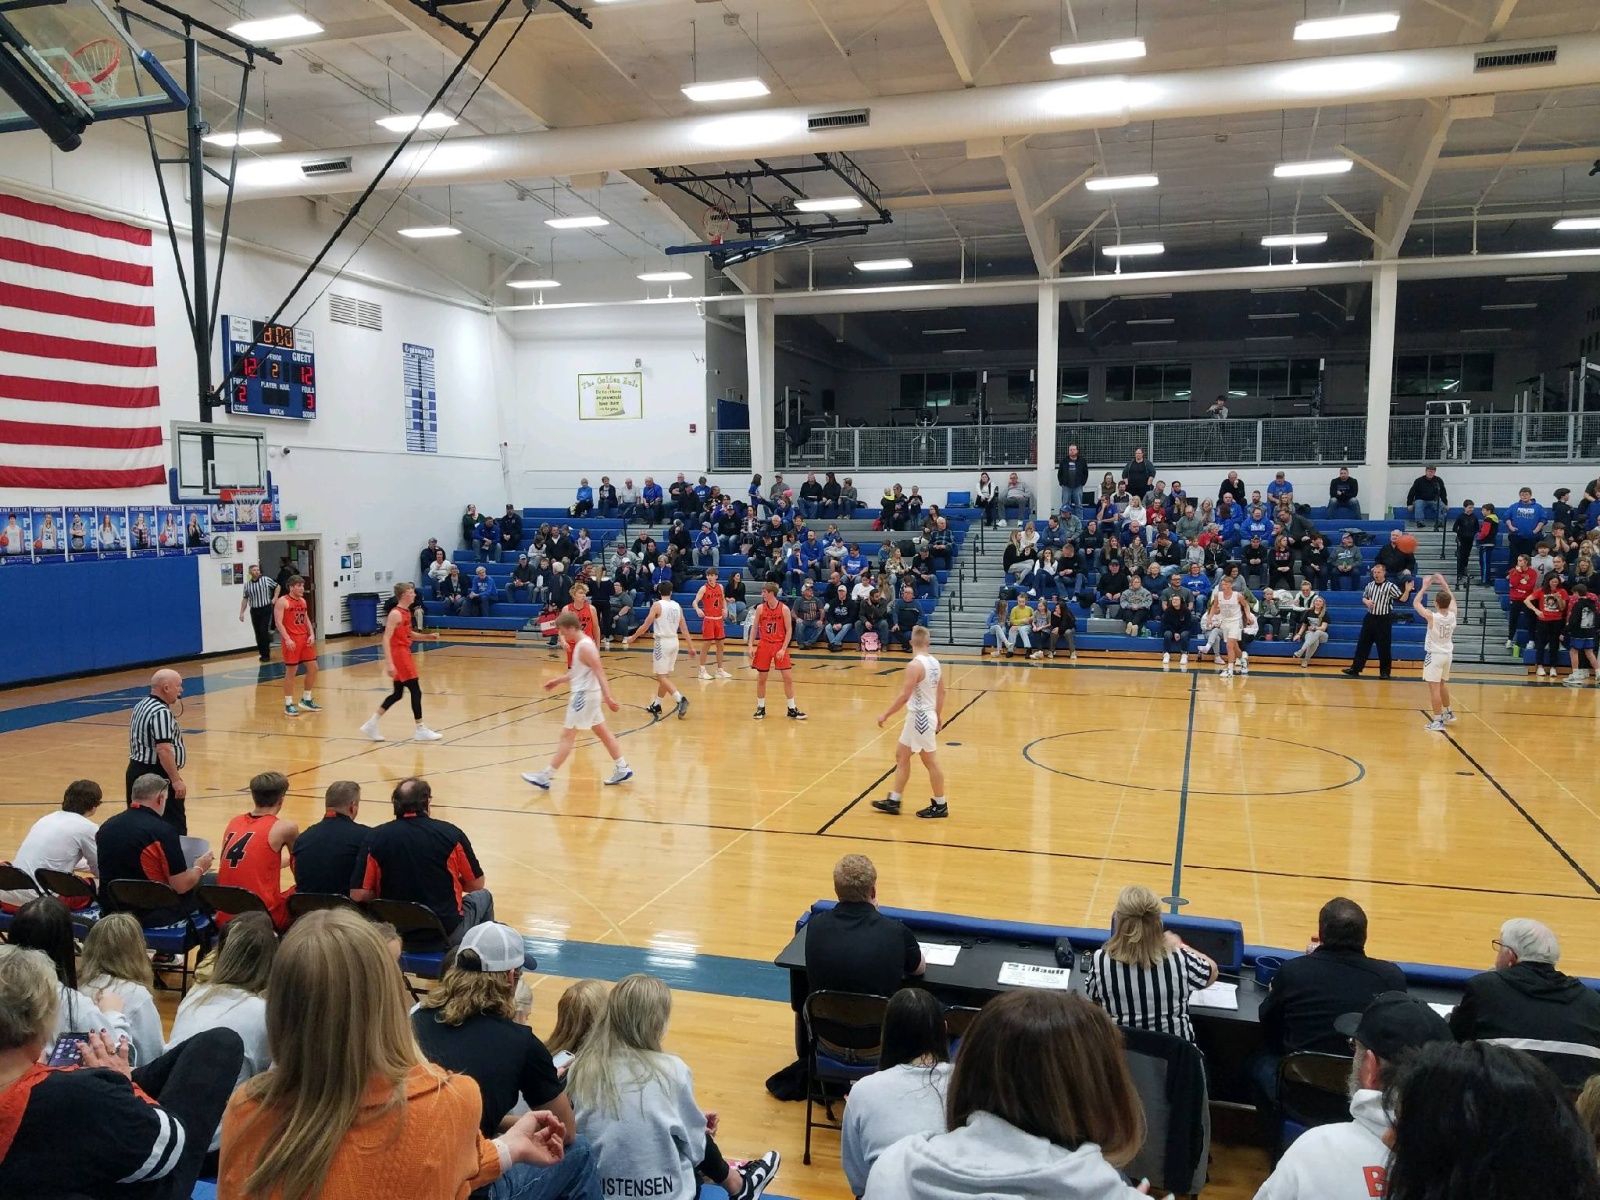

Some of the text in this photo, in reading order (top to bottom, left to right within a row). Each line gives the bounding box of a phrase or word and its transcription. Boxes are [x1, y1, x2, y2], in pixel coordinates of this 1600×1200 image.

[235, 343, 255, 356] HOM
[266, 353, 282, 361] PERIOD
[291, 352, 312, 363] GUEST
[244, 357, 258, 377] 12
[271, 362, 279, 378] 2
[301, 366, 313, 385] 12
[260, 380, 277, 389] PLAYER
[301, 386, 315, 394] FOULS
[238, 385, 247, 402] 2
[233, 404, 249, 412] SCORE
[306, 393, 314, 410] 3
[1537, 563, 1545, 574] 4
[713, 599, 719, 607] 4
[766, 622, 777, 634] 31
[220, 832, 256, 869] 14
[600, 1175, 673, 1197] ISTENSEN
[1362, 1165, 1388, 1197] B
